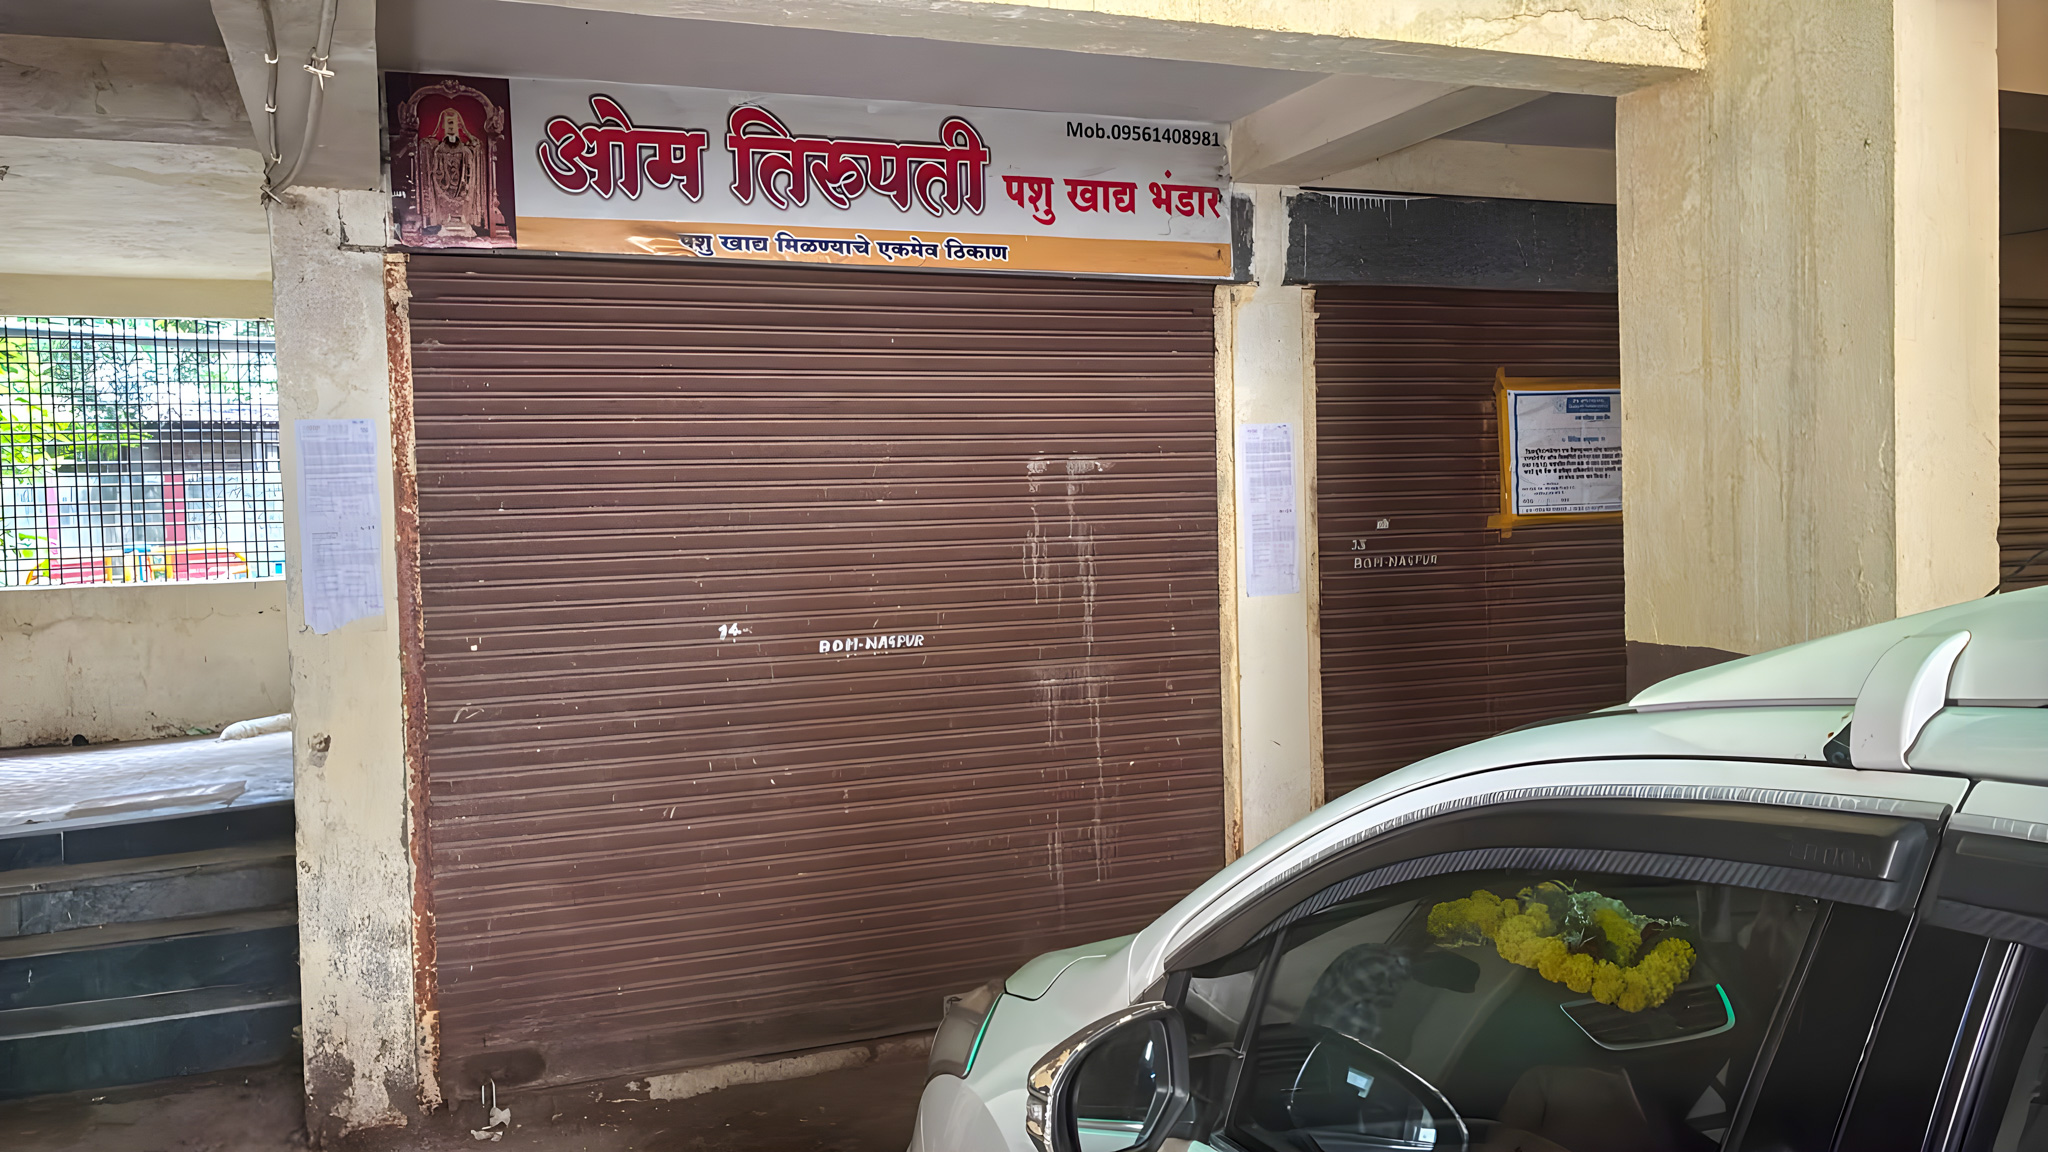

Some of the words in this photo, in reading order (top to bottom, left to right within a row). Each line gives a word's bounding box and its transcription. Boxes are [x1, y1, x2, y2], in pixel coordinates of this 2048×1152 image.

[538, 94, 708, 203] ओम
[1066, 121, 1220, 147] Mob.09561408981
[1001, 175, 1056, 226] पशु
[1063, 178, 1138, 214] खाद्य
[1149, 169, 1220, 218] भंडार
[717, 234, 769, 253] खाद्य
[774, 231, 870, 256] मिळण्याचे
[875, 236, 939, 261] एकमेव
[942, 237, 1009, 261] ठिकाण
